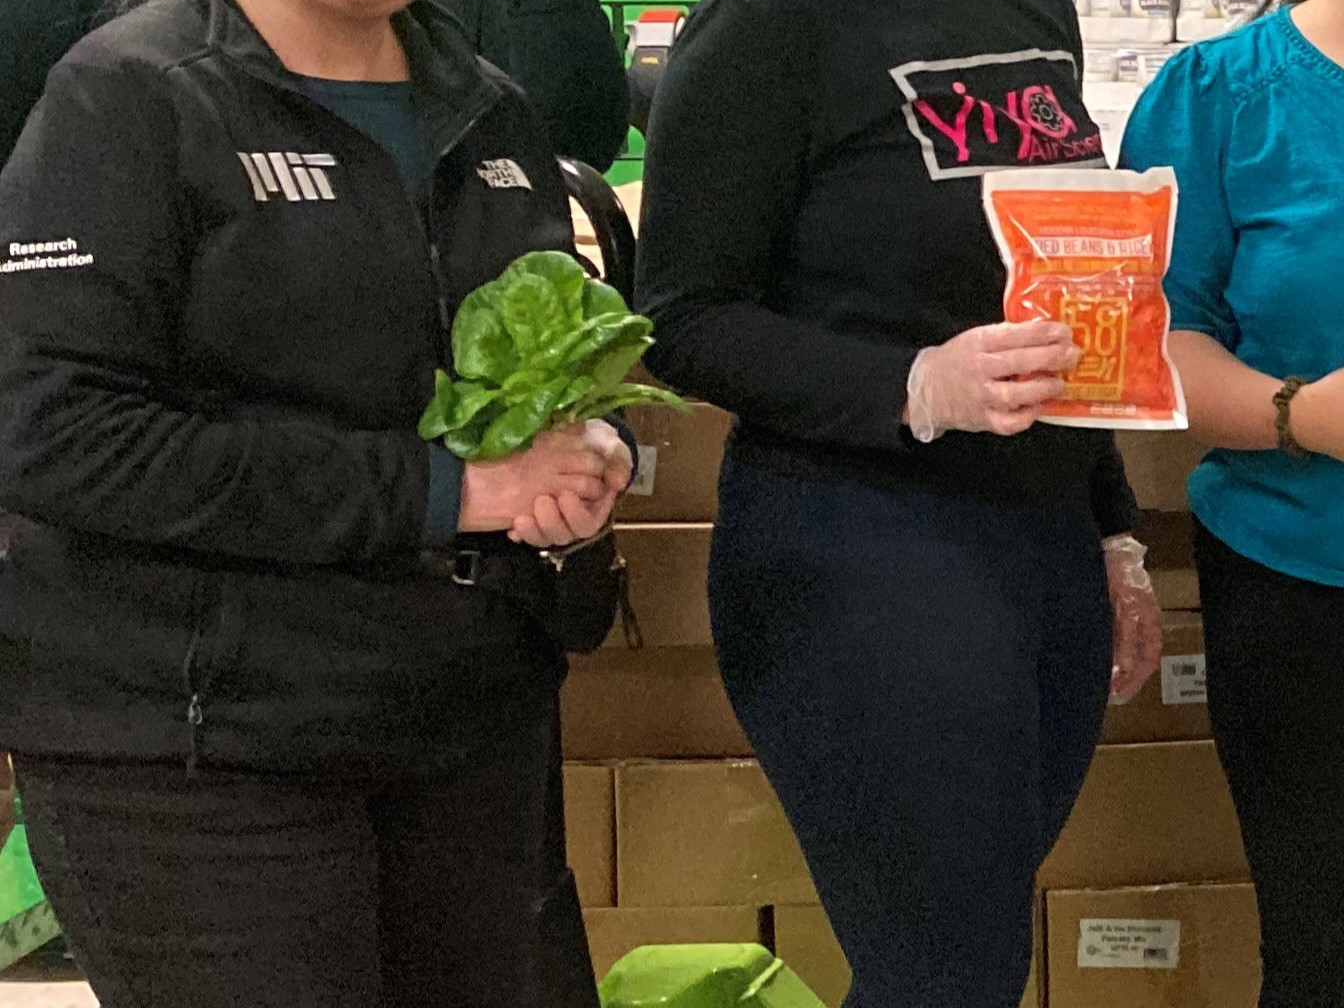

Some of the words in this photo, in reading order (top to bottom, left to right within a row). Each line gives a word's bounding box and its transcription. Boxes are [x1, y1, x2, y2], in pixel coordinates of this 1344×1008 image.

[237, 152, 336, 201] MIT
[9, 237, 77, 256] Research
[1063, 238, 1104, 256] BEANS
[1119, 238, 1149, 256] RICE
[0, 253, 94, 273] dministration
